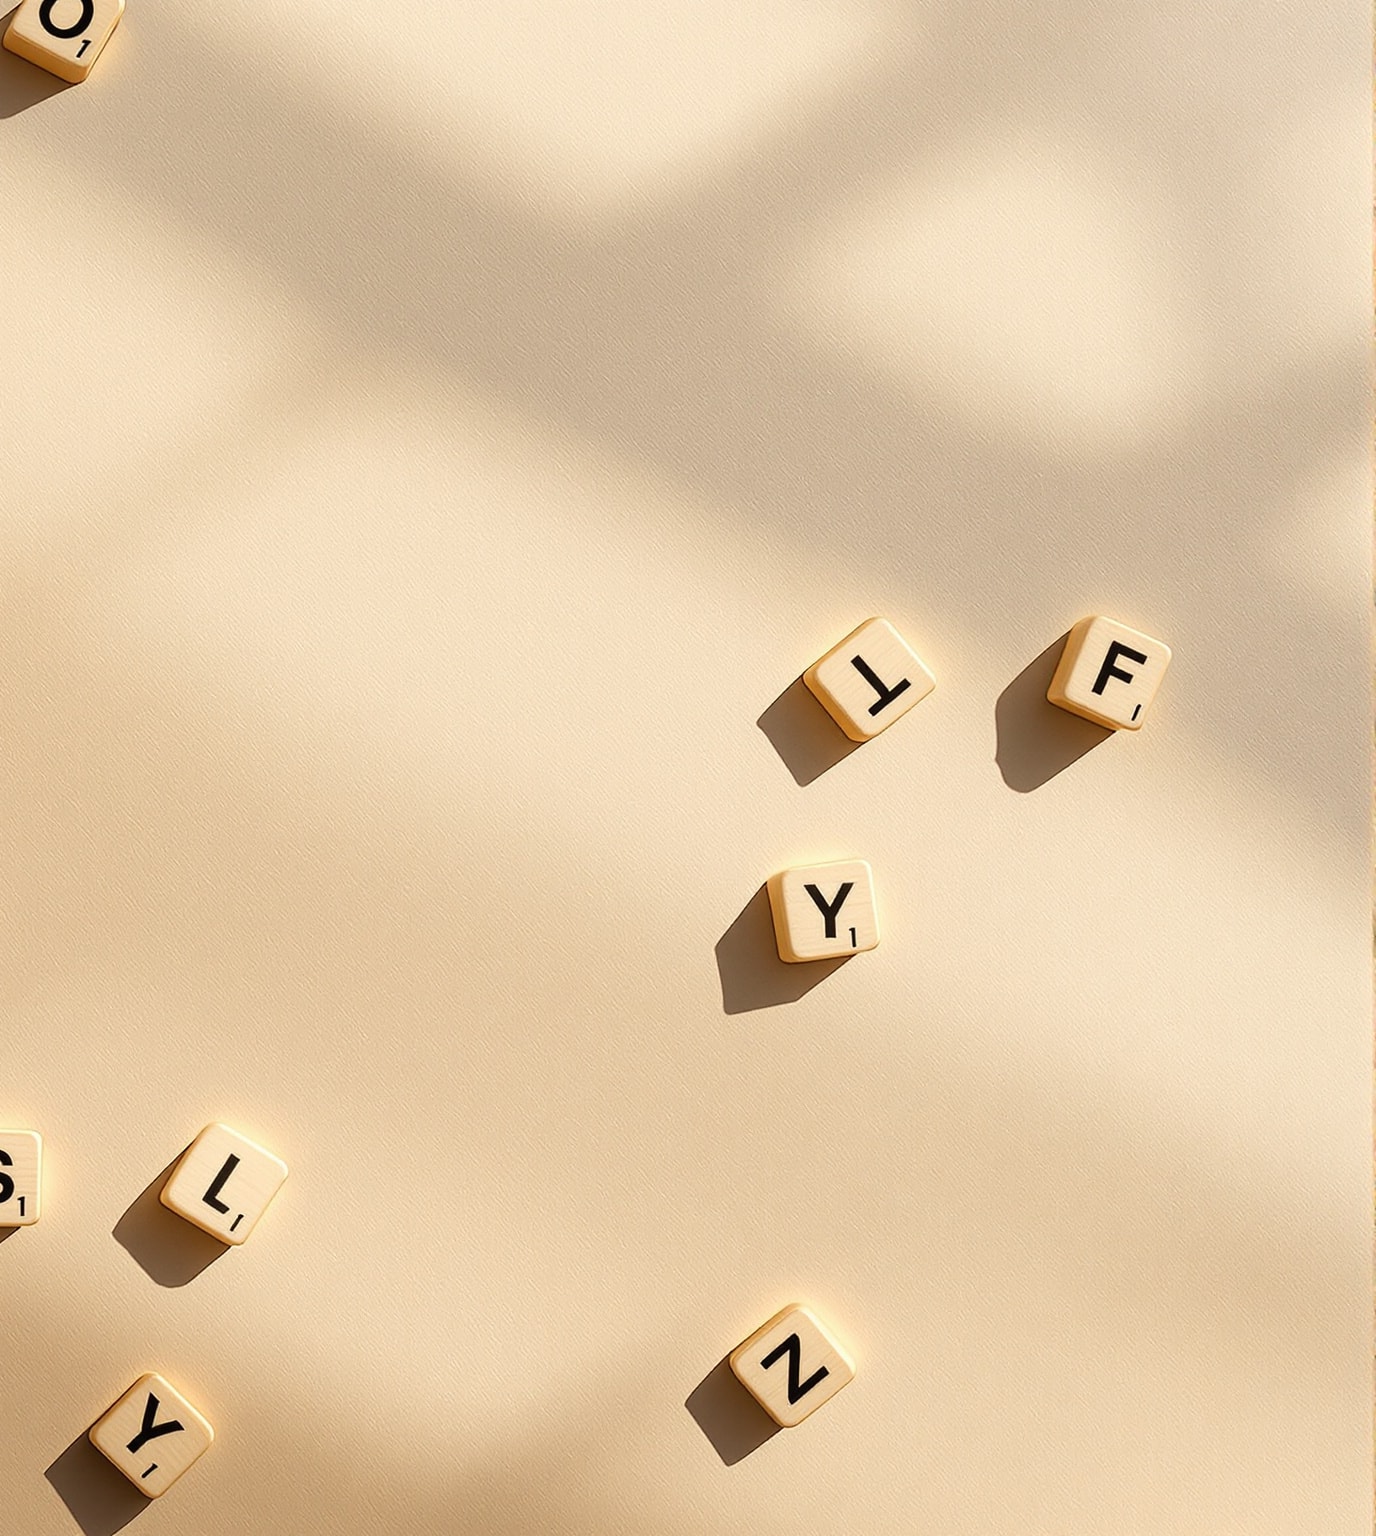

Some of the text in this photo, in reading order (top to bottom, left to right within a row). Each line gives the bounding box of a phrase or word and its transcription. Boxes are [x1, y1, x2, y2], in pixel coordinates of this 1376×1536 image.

[850, 654, 912, 717] T
[1091, 640, 1148, 696] F
[803, 882, 854, 939] Y
[202, 1153, 241, 1215] L
[125, 1392, 185, 1454] Y
